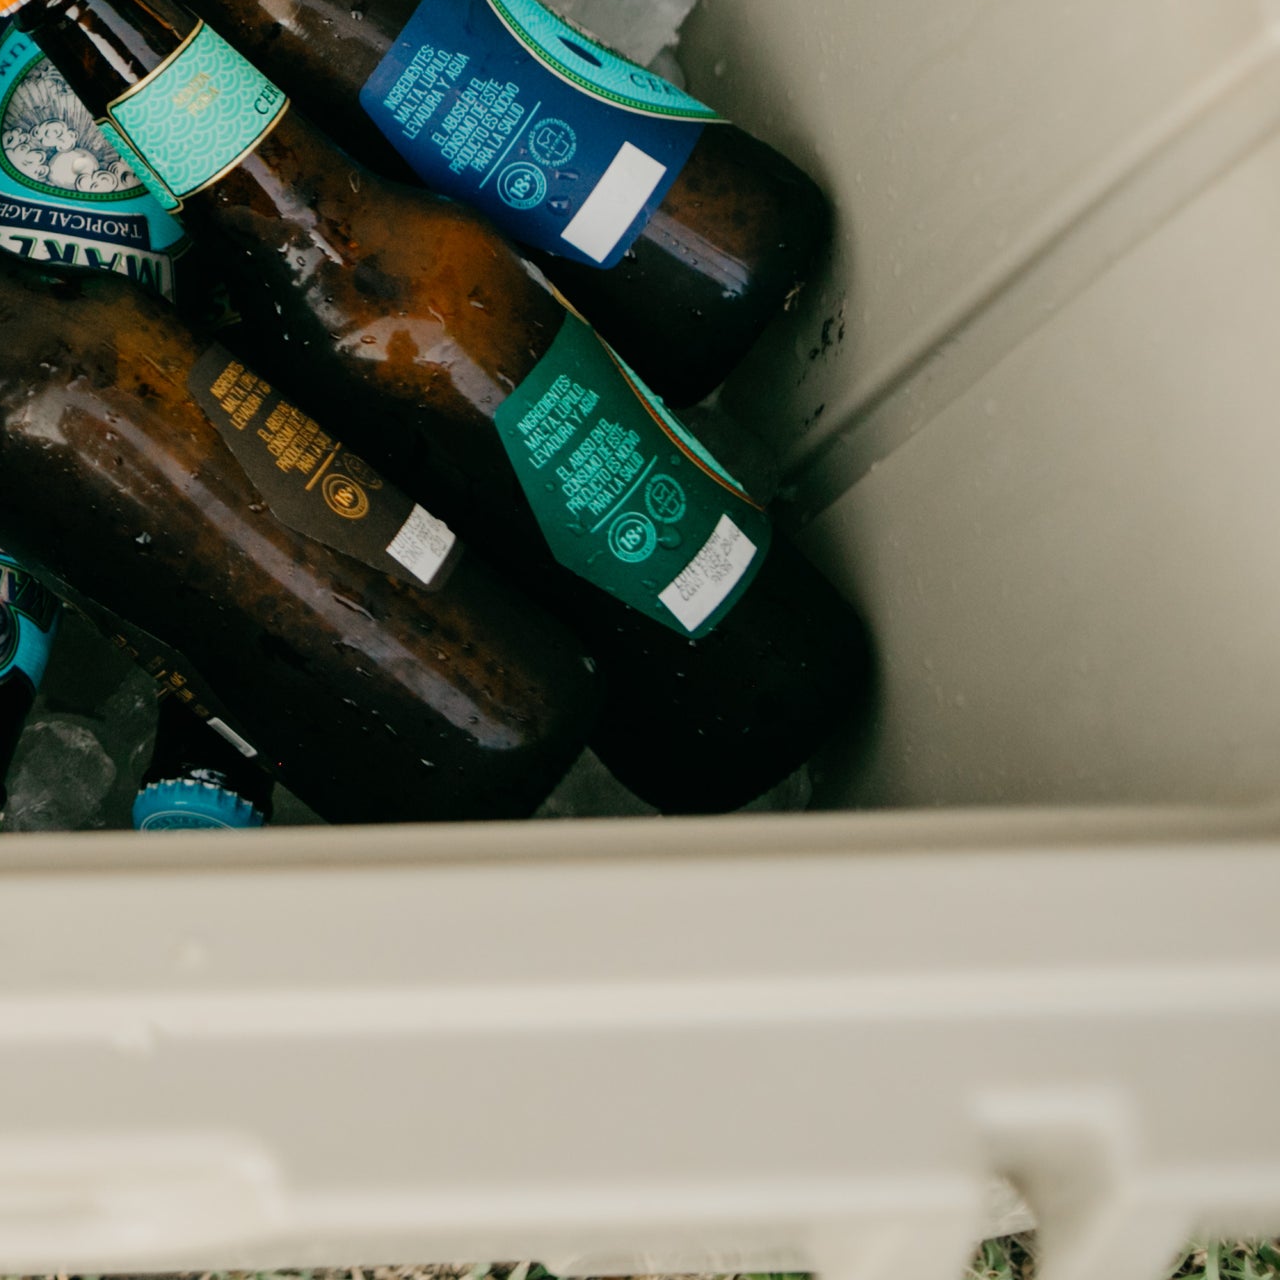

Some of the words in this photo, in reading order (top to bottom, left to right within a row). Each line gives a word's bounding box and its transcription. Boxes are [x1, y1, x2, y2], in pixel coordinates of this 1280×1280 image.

[382, 41, 436, 111] INGREDIENTES:
[443, 49, 470, 80] AGUA
[436, 76, 452, 91] Y
[460, 86, 479, 104] EN
[469, 73, 487, 91] EL
[478, 78, 503, 106] ESTE
[400, 85, 444, 141] LEVADURA
[439, 99, 470, 134] ABUSO
[469, 101, 488, 119] DE
[430, 128, 448, 146] EL
[439, 113, 478, 161] CONSUMO
[447, 123, 490, 176] PRODUCTO
[480, 112, 499, 130] ES
[469, 143, 495, 173] PARA
[486, 130, 505, 149] LA
[496, 101, 525, 135] SALUD
[48, 211, 143, 239] TROPICAL
[569, 409, 585, 424] Y
[575, 389, 601, 416] AGUA
[588, 425, 607, 444] EN
[597, 416, 614, 432] EL
[603, 422, 629, 448] ESTE
[527, 417, 576, 471] LEVADURA
[566, 436, 597, 470] ABUSO
[595, 442, 613, 460] DE
[554, 463, 573, 481] EL
[560, 451, 604, 499] CONSUMO
[564, 464, 612, 517] PRODUCTO
[603, 455, 622, 473] ES
[586, 486, 615, 517] PARA
[607, 476, 625, 494] LA
[617, 450, 646, 482] SALUD
